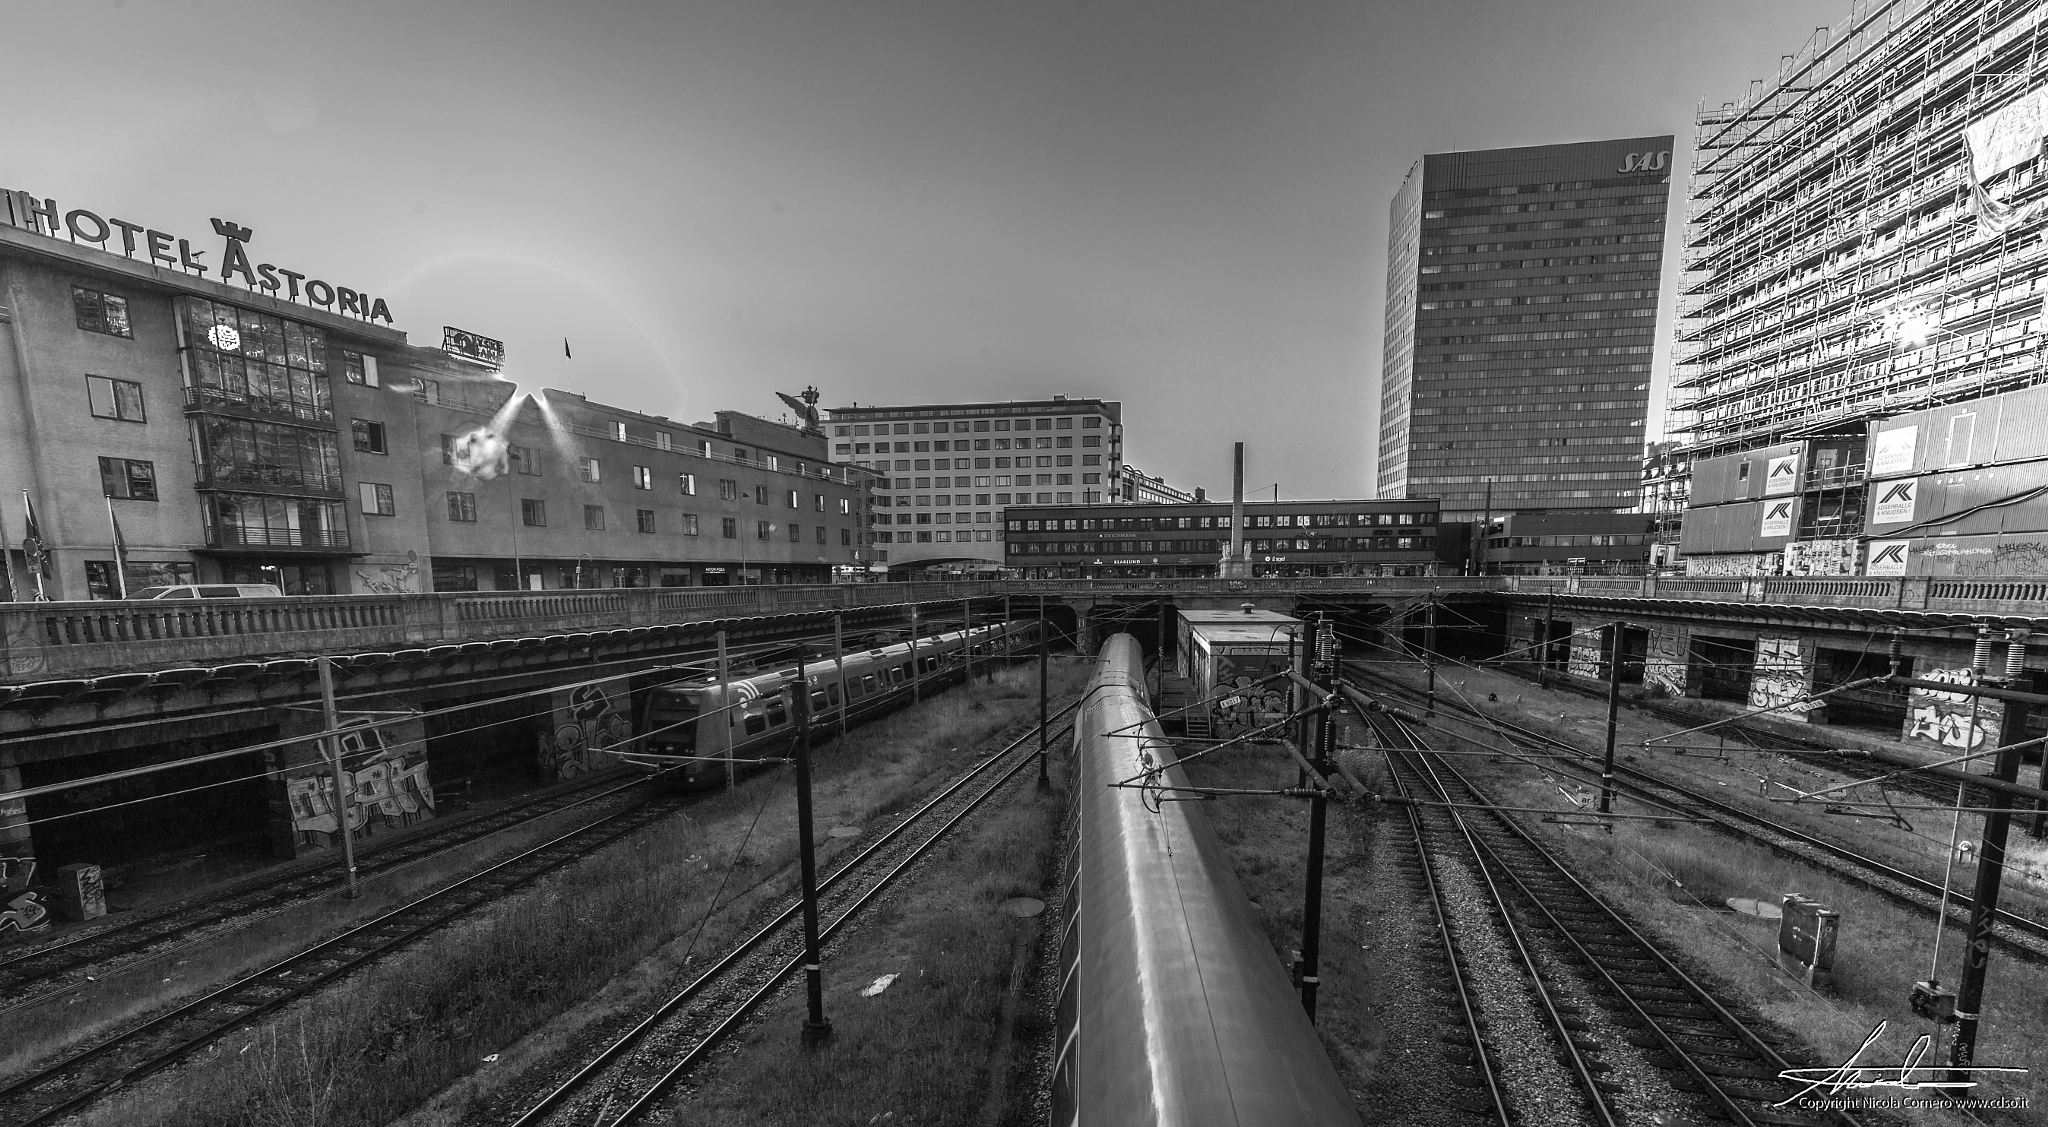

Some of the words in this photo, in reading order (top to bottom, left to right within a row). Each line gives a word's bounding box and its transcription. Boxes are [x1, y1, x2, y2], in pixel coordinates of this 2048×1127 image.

[1618, 151, 1670, 173] SAS
[19, 189, 208, 272] HOTEL
[220, 236, 394, 324] ASTORIA
